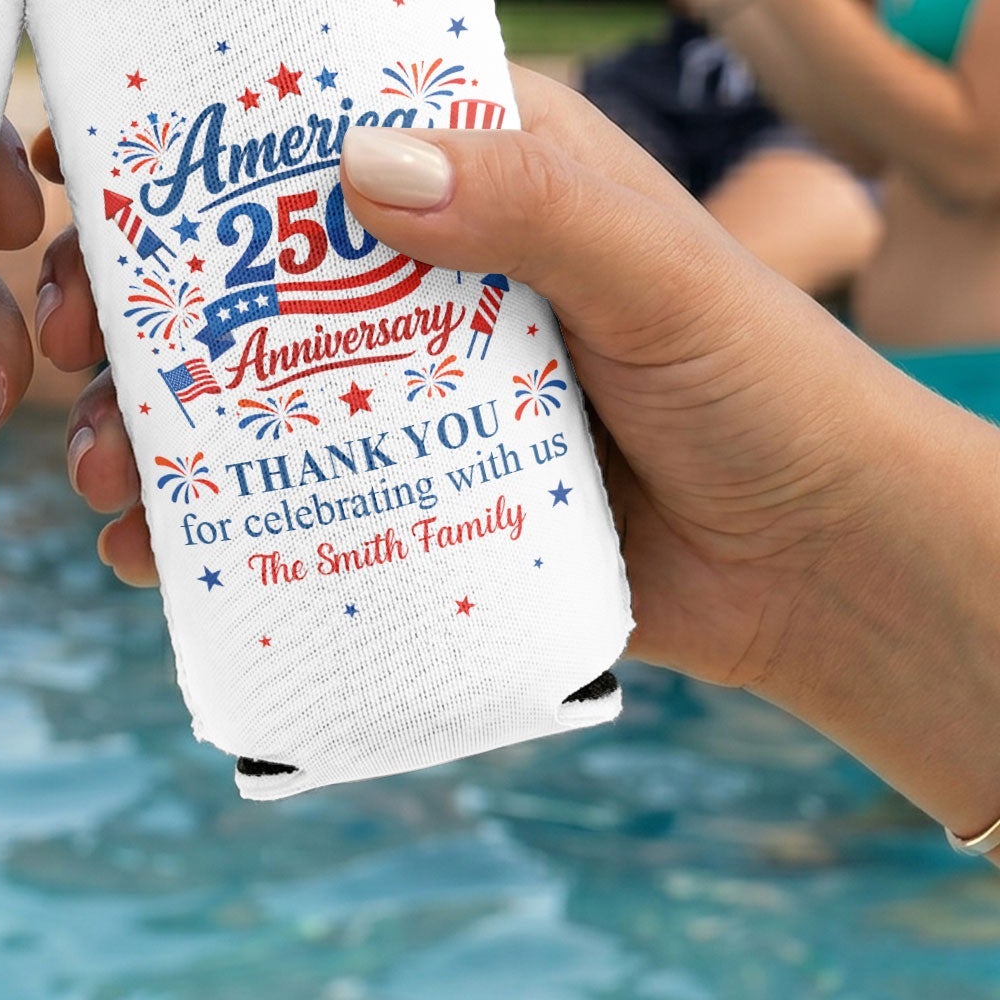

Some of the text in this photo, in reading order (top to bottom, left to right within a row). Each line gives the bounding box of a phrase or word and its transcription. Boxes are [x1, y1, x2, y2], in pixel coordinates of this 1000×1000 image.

[225, 300, 466, 389] Anniversary
[180, 432, 568, 546] for celebrating with us
[226, 400, 502, 498] THANK YOU
[247, 495, 527, 587] The Smith Family
